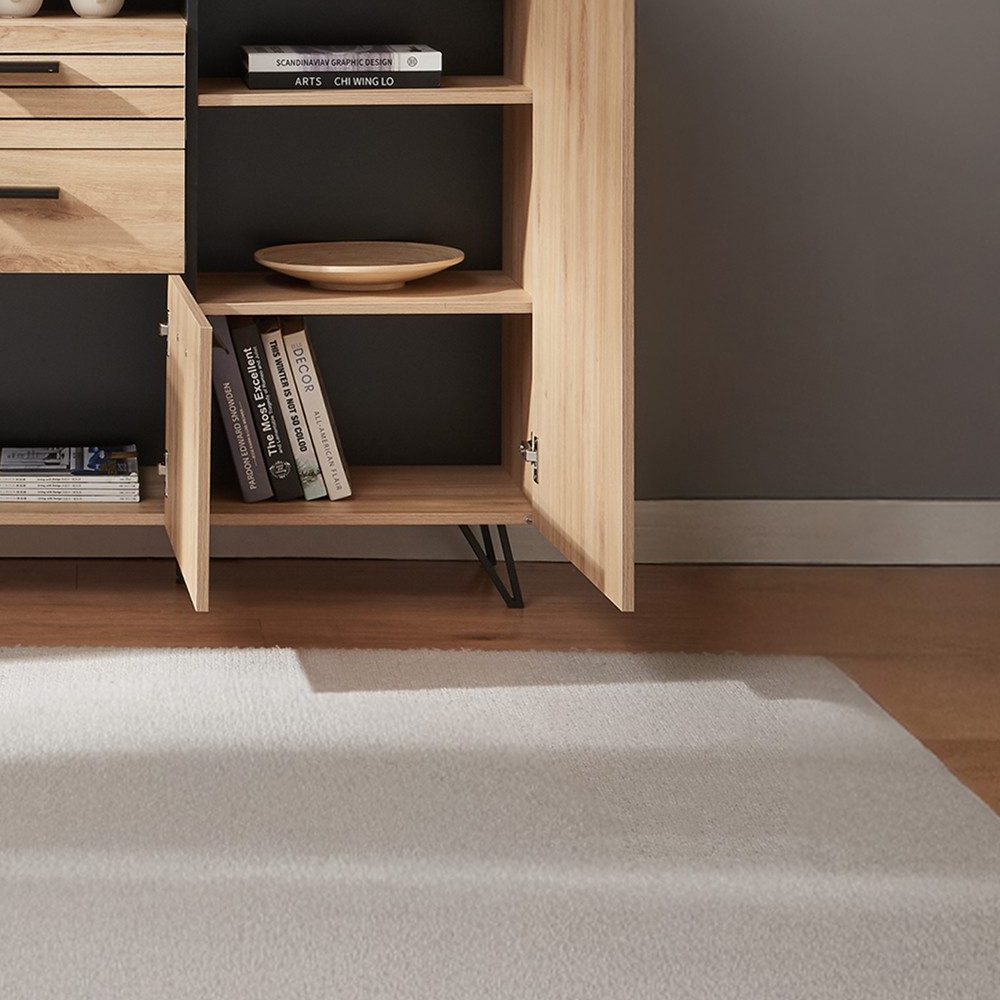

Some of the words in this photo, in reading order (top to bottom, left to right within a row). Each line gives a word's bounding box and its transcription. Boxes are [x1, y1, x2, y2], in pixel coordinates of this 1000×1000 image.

[331, 58, 364, 67] GRAPHIC
[364, 58, 393, 67] DESIGN
[294, 77, 322, 86] ARTS
[334, 77, 350, 86] CHI
[353, 77, 379, 86] WING
[381, 77, 394, 86] LO
[269, 340, 280, 358] THIS
[243, 347, 264, 401] Excellent
[274, 358, 289, 388] WINTER
[293, 348, 315, 392] DECOR
[222, 382, 240, 422] SNOWDEN
[283, 389, 292, 398] IS
[286, 398, 298, 414] NOT
[257, 402, 272, 433] Most
[291, 414, 300, 427] SO
[233, 423, 249, 457] EDWARD
[266, 434, 277, 457] The
[314, 411, 336, 467] ALL-AMERICAN
[331, 467, 343, 491] FLAIR
[242, 457, 257, 490] PARDON
